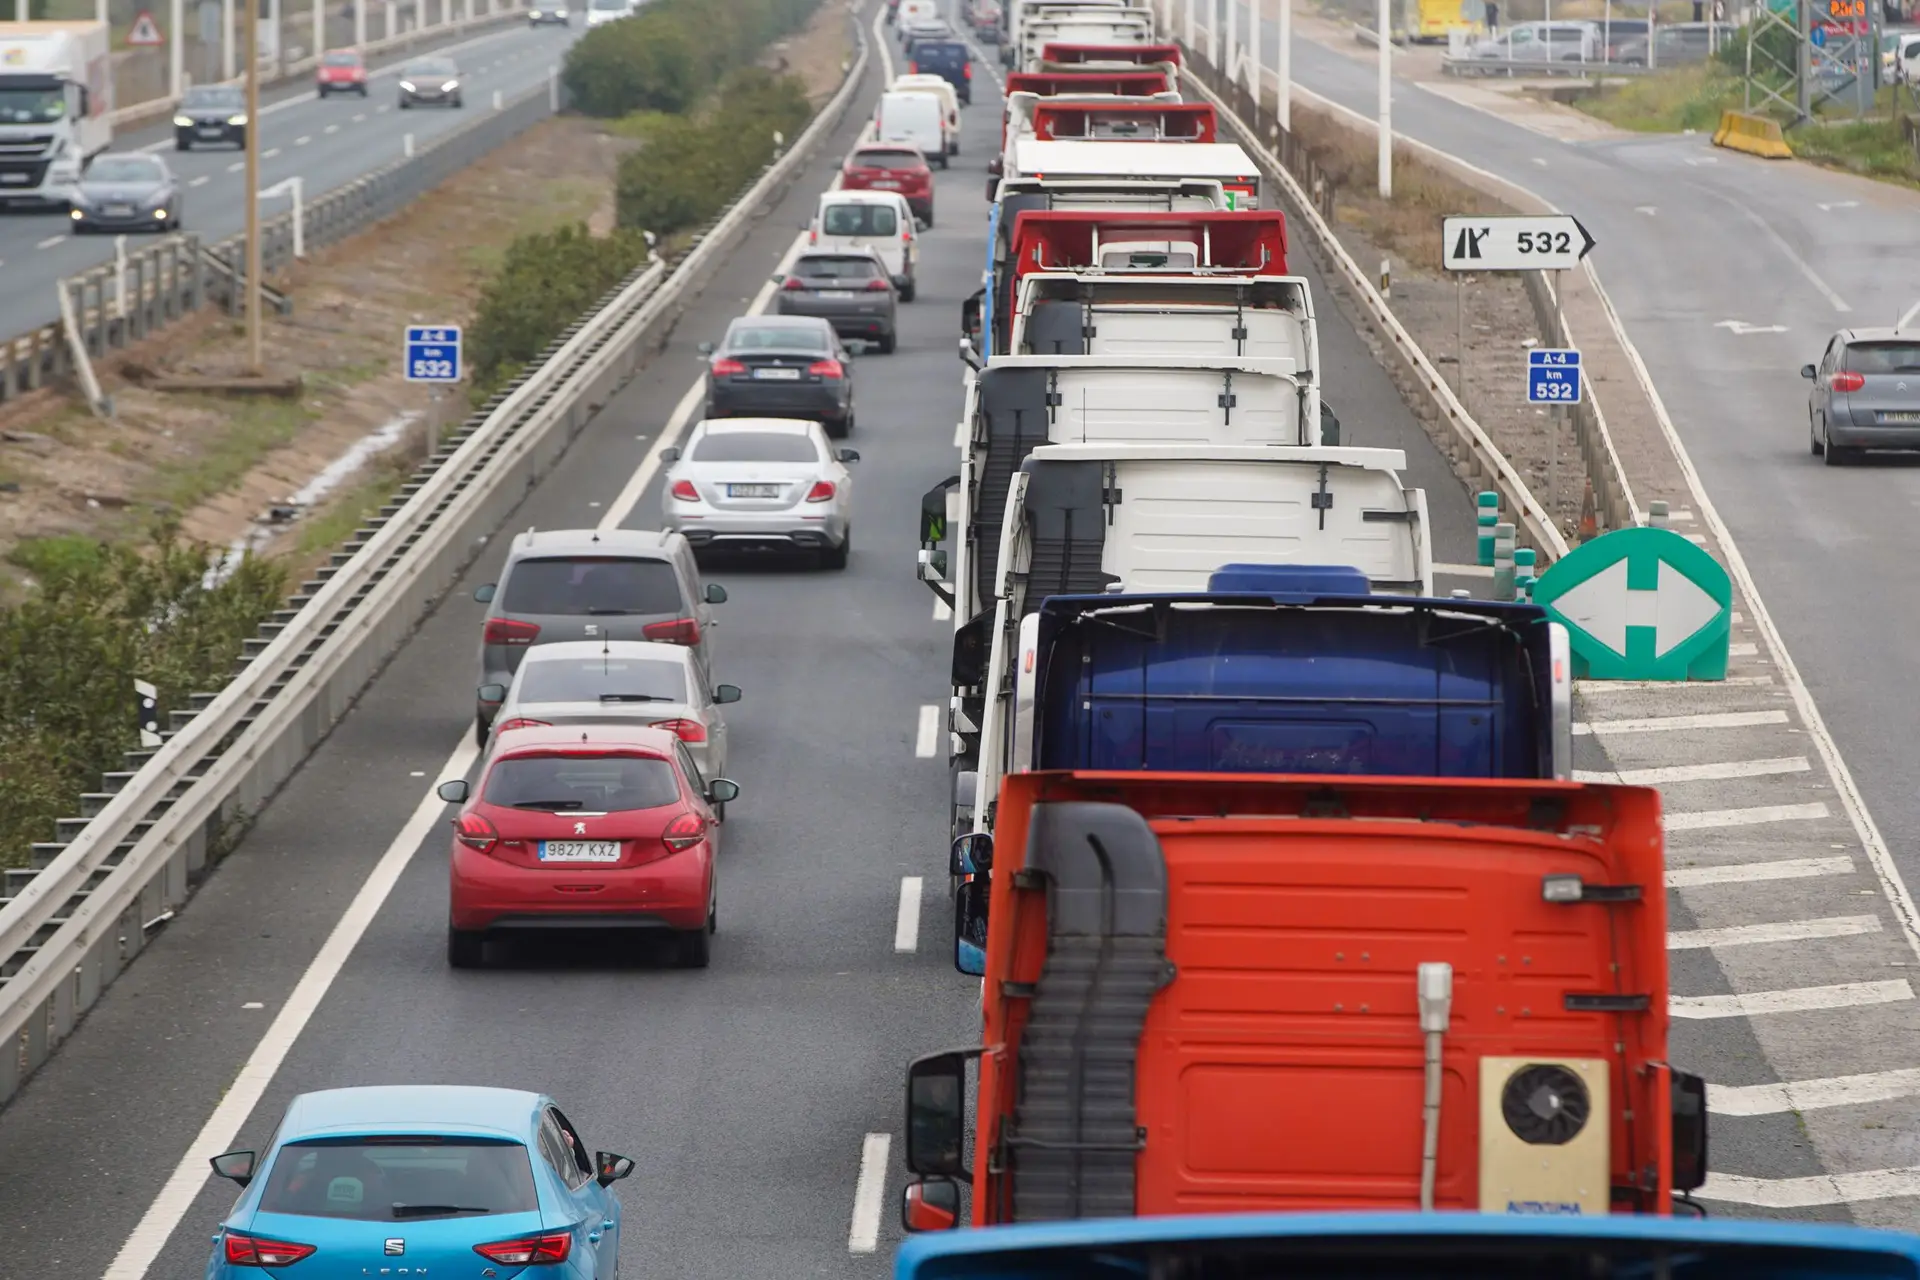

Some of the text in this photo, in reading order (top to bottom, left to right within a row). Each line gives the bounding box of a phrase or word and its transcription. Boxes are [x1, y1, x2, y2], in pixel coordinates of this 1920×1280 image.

[1517, 232, 1571, 254] 532
[420, 330, 446, 341] A-4
[1543, 352, 1567, 364] A-4
[414, 360, 453, 377] 532
[1546, 369, 1563, 380] km
[1536, 382, 1573, 399] 532
[548, 843, 616, 857] 9827 KXZ
[362, 1267, 428, 1276] LEON
